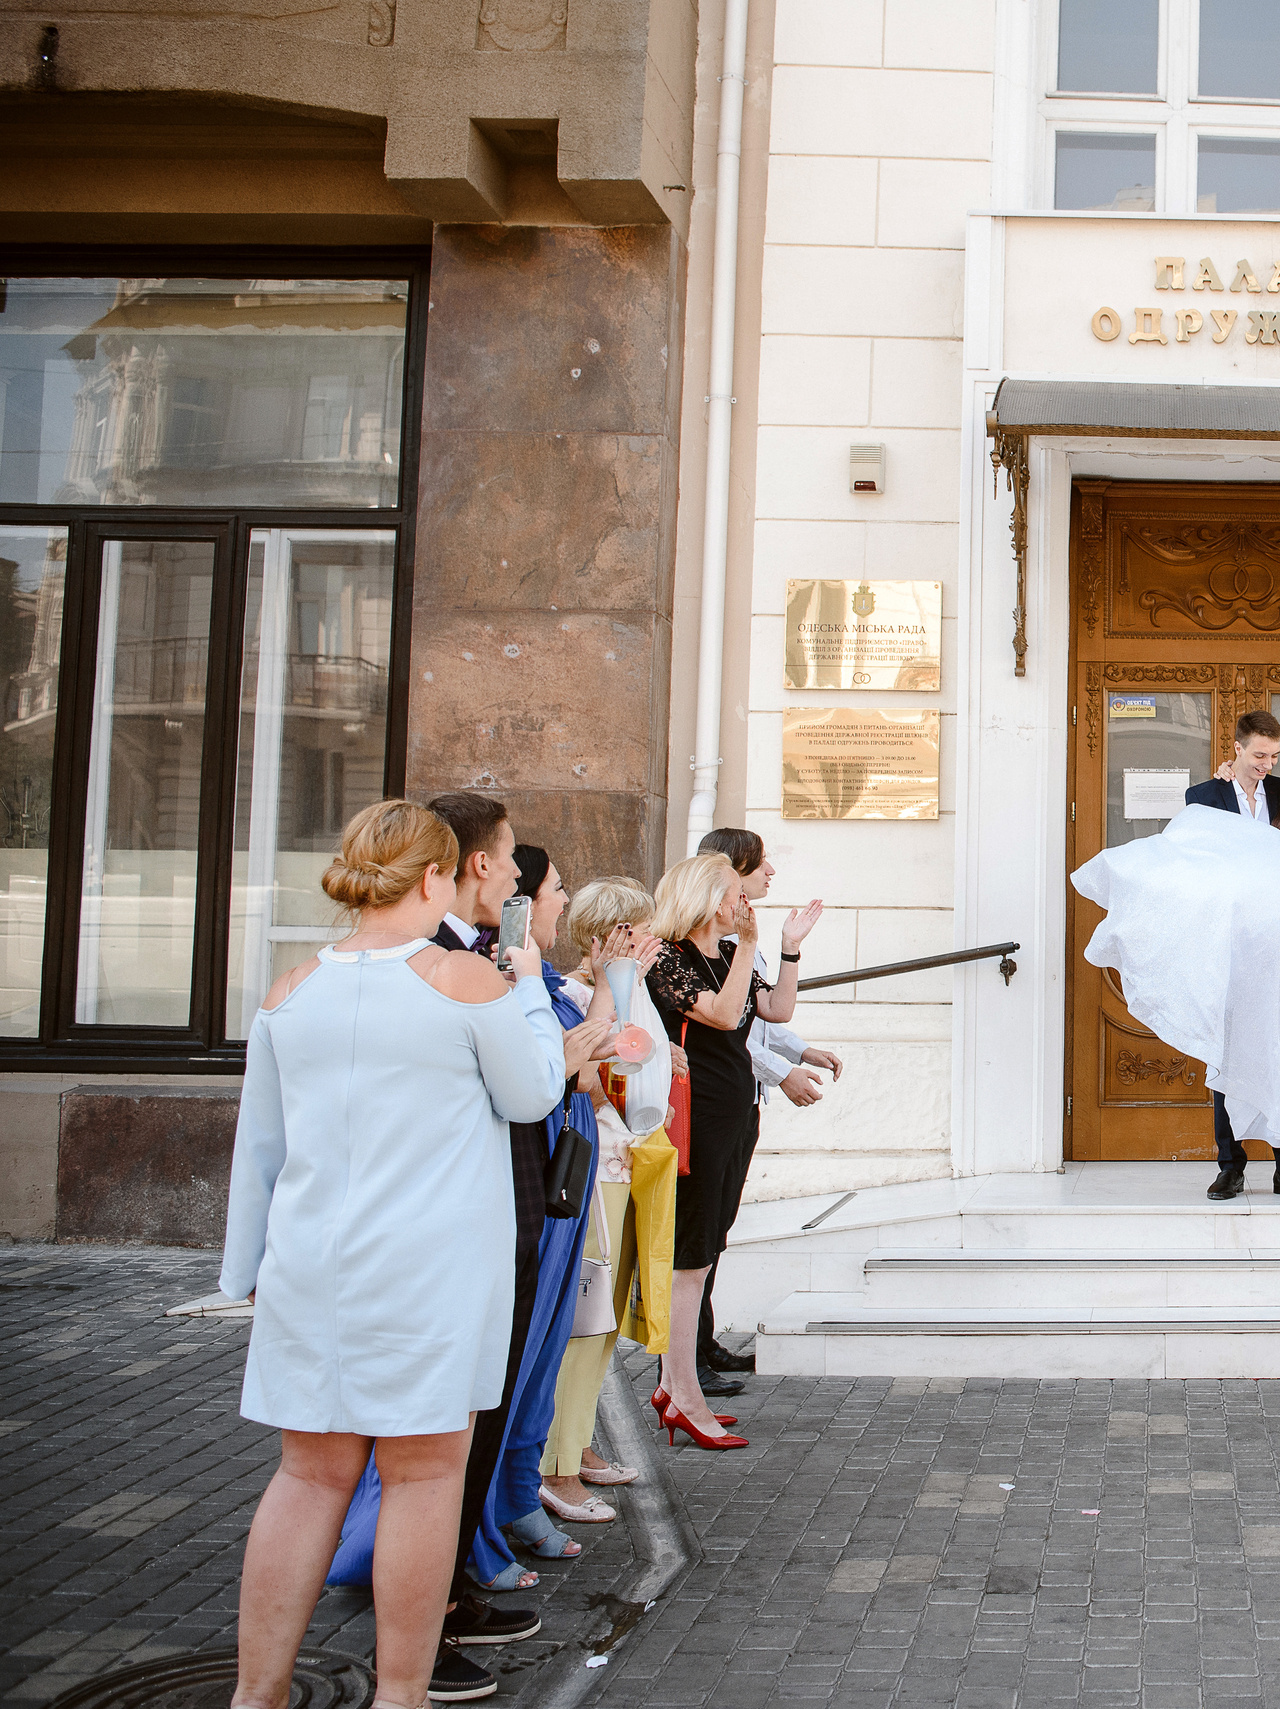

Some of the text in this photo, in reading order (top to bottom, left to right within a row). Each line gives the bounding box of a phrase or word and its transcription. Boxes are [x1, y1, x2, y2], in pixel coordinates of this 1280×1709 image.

[797, 623, 926, 635] ОДЕСЬКА МІСЬКА РАДА
